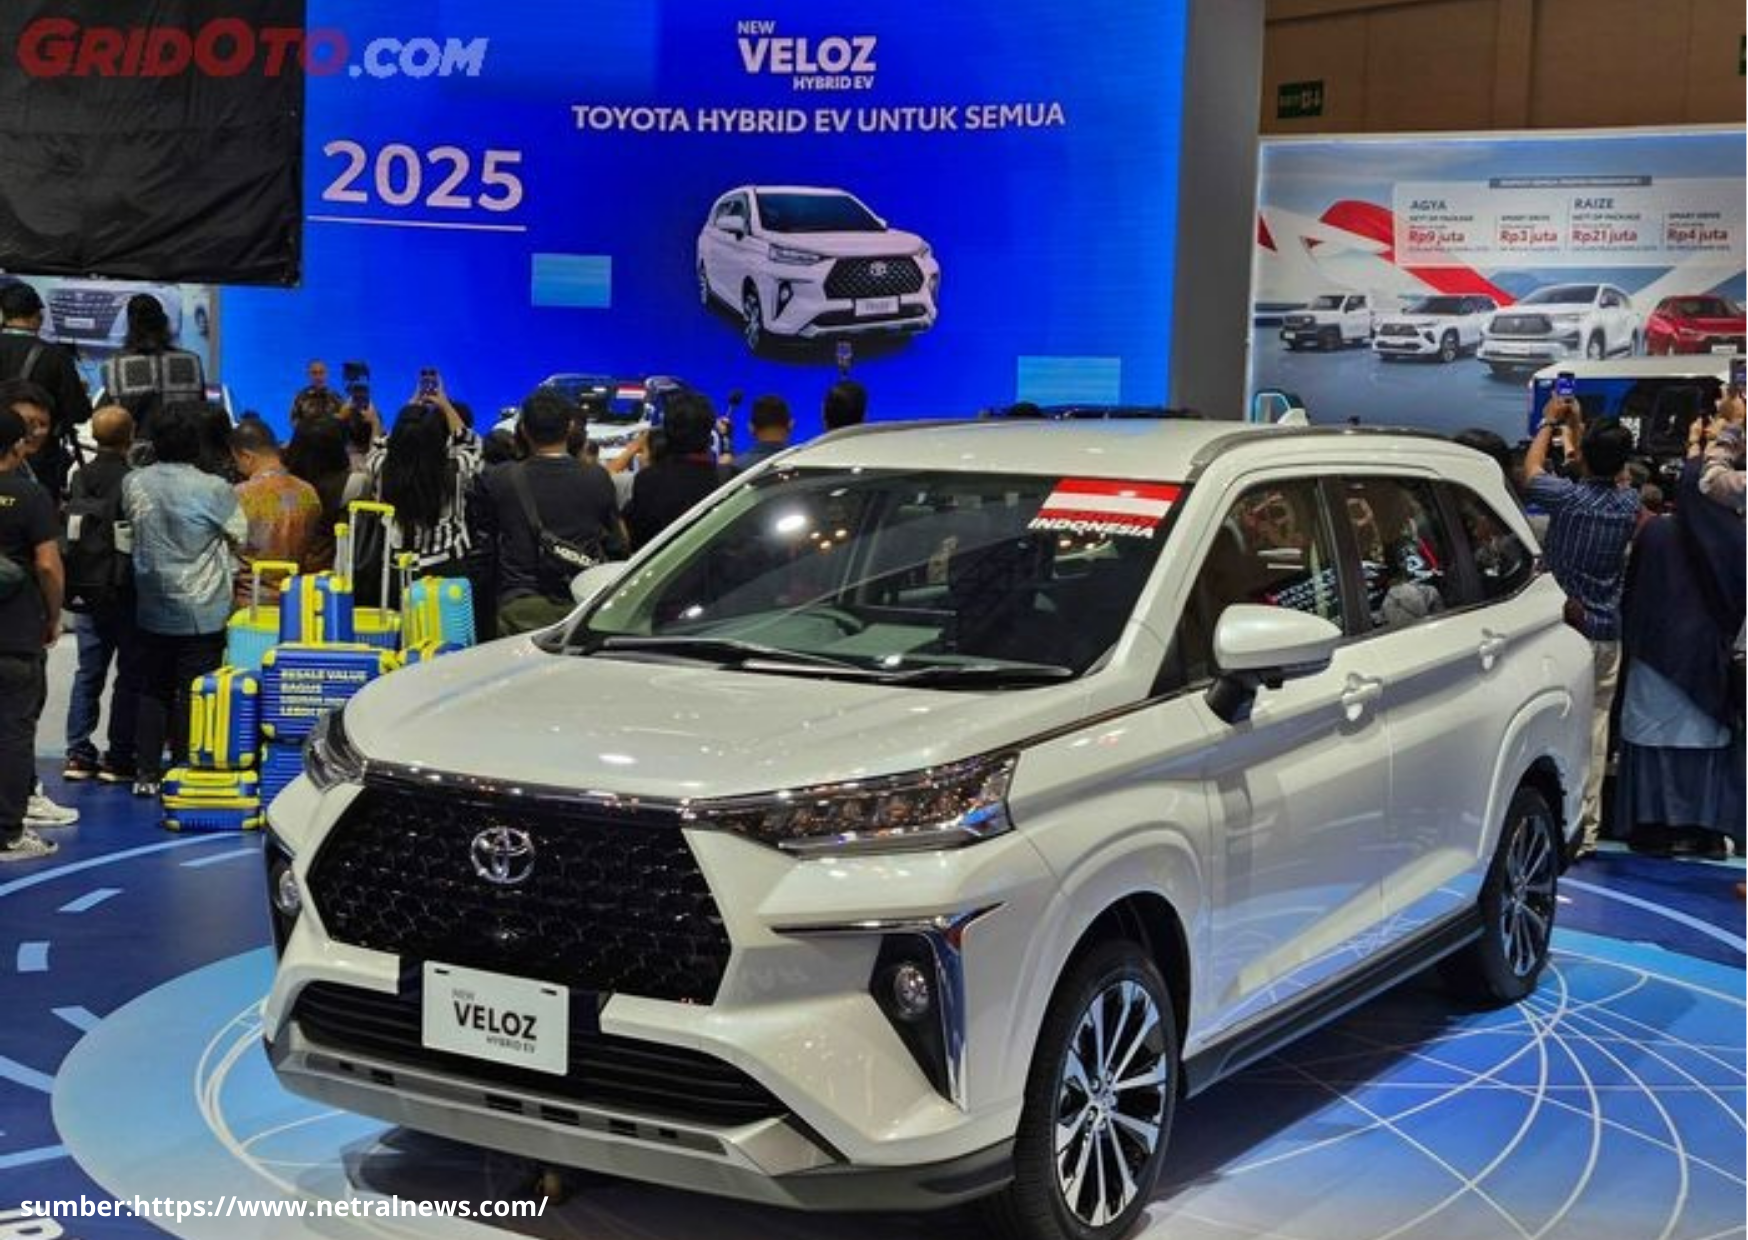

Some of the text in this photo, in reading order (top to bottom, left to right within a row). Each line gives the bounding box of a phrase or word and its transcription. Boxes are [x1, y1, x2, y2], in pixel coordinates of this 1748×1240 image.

[737, 20, 776, 35] NEW
[737, 36, 877, 73] VELOZ
[793, 75, 874, 91] HYBRID EV
[571, 102, 1066, 133] TOYOTA HYBRID EV UNTUK SEMUA
[321, 139, 524, 212] 2025
[1409, 200, 1447, 211] AGYA
[1573, 198, 1614, 210] RAIZE
[1437, 231, 1466, 245] juta
[1530, 231, 1558, 244] juta
[1608, 229, 1638, 243] juta
[1667, 228, 1729, 242] Rp4 juta
[1027, 517, 1155, 539] INDONESIA
[453, 1000, 537, 1041] VELOZ
[486, 1035, 536, 1053] HYBRID EV
